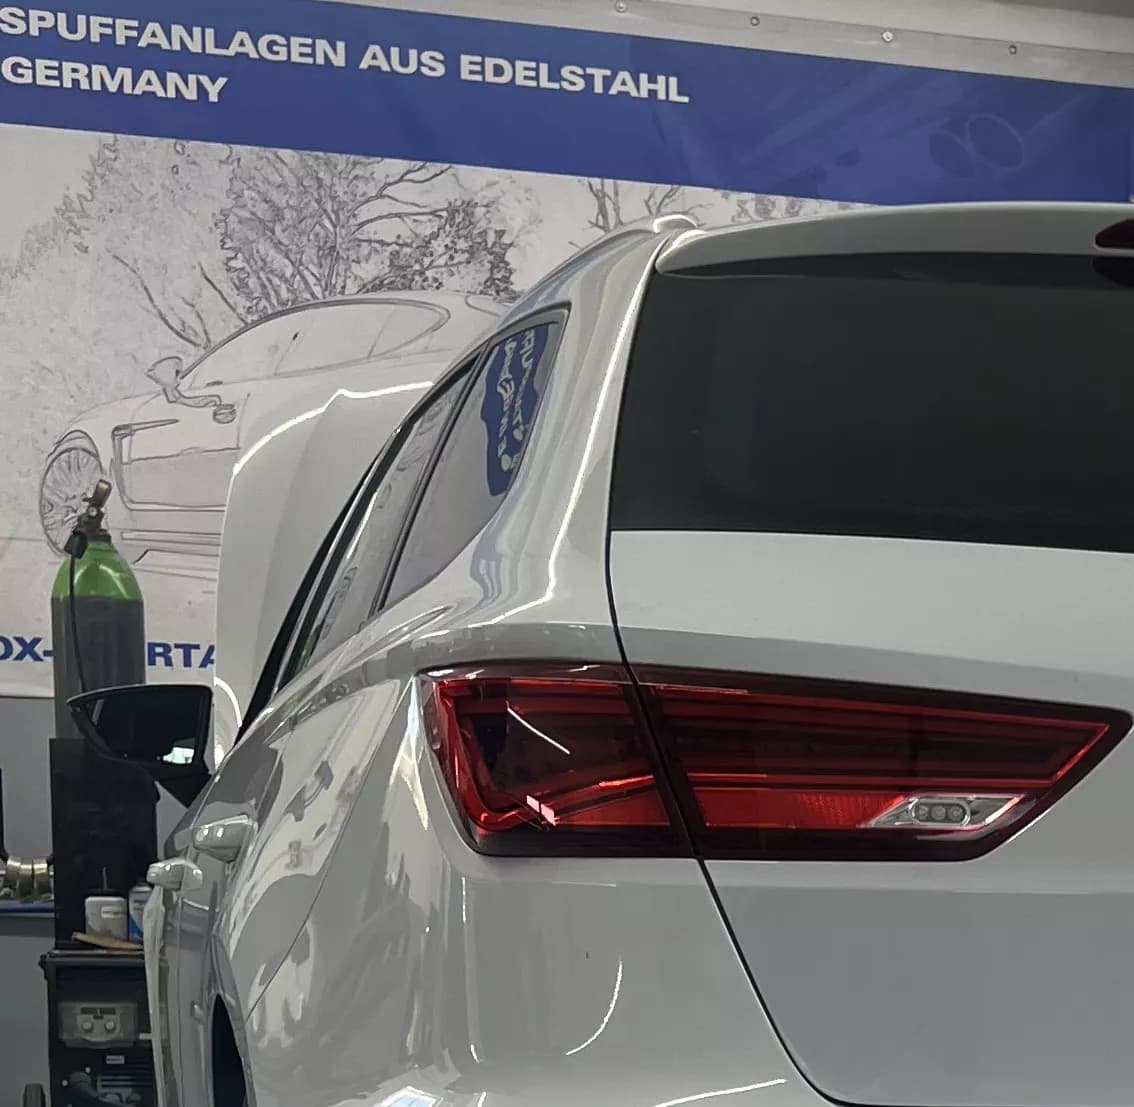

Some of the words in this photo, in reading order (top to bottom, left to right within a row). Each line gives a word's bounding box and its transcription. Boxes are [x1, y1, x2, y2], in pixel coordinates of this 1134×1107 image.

[0, 7, 346, 67] SPUFFANLAGEN
[359, 44, 446, 77] AUS
[460, 54, 690, 103] EDELSTAHL
[1, 56, 228, 102] GERMANY
